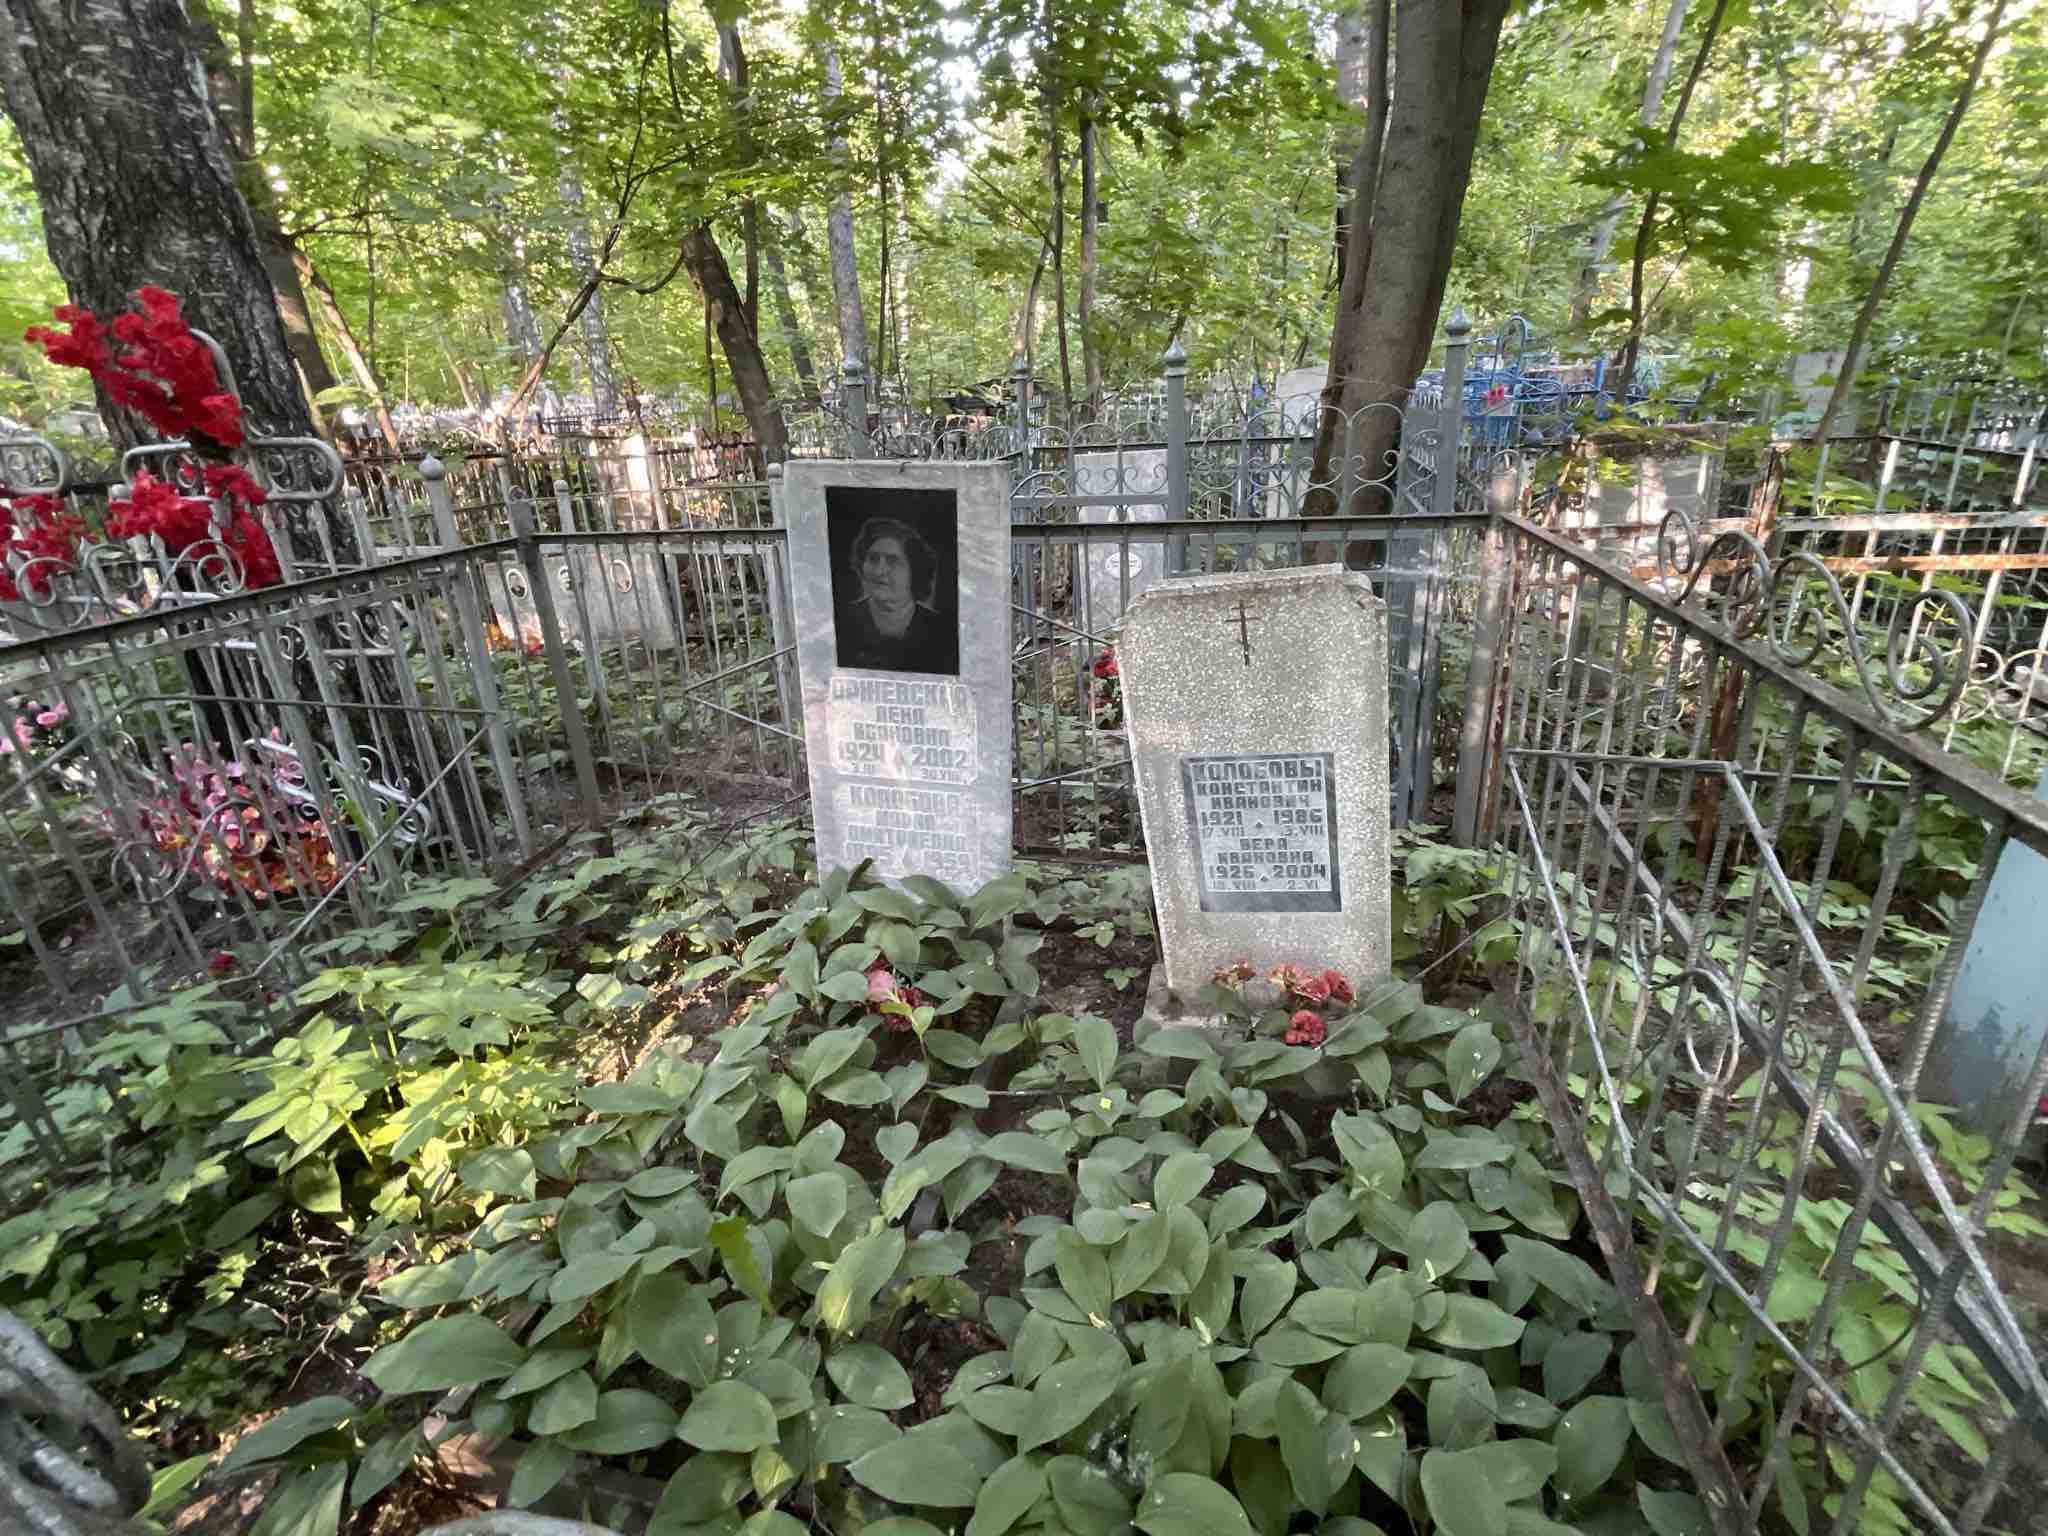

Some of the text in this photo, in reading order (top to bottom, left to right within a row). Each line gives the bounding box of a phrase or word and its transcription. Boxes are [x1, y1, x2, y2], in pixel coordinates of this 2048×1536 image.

[839, 741, 968, 768] 1924 2002
[1197, 779, 1322, 795] КОНСТАНТИН
[1211, 795, 1310, 809] ИВАНОВИЧ
[1201, 809, 1323, 826] 1921 1986
[1240, 838, 1288, 850] ВЕРА
[1217, 851, 1314, 864] ИВАНОВНА
[1272, 864, 1327, 878] 2004
